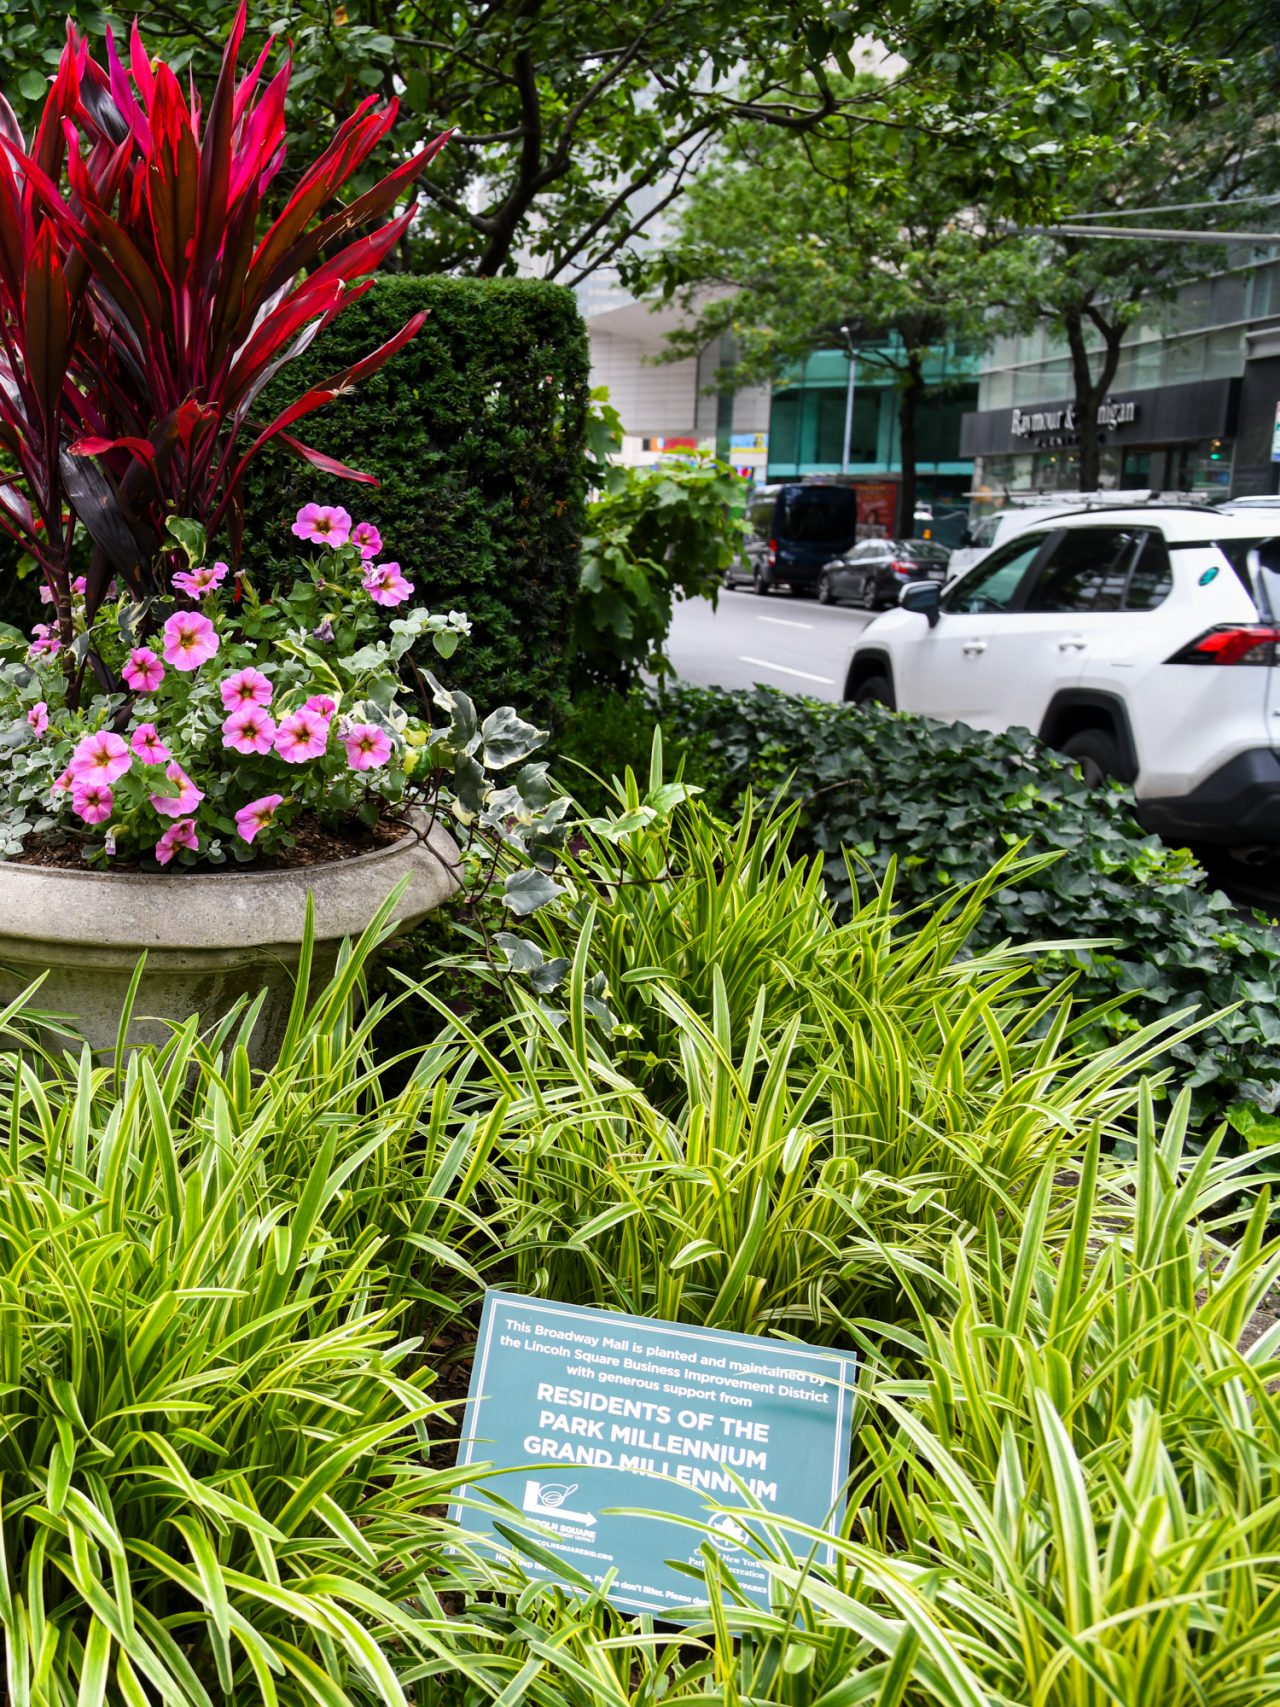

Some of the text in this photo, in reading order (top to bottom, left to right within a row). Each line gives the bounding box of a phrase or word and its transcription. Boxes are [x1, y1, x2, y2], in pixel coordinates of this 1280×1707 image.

[1097, 398, 1134, 430] nigan
[505, 1319, 827, 1387] This Broadway Mall is planted and maintained by
[500, 1335, 829, 1404] the Lincoln Square Business Improvement District
[566, 1366, 752, 1408] with generous support from
[536, 1382, 770, 1443] RESIDENTS OF THE
[523, 1435, 612, 1467] GRAND
[539, 1410, 768, 1470] PARK MILLENNIUM
[560, 1524, 596, 1539] SQUARE
[531, 1538, 614, 1561] COLNSQUAREBID.ORG
[722, 1553, 740, 1564] New
[741, 1557, 761, 1569] York
[726, 1566, 765, 1580] ecreation
[621, 1581, 642, 1592] don't
[643, 1586, 665, 1597] litter.
[666, 1590, 691, 1603] Please
